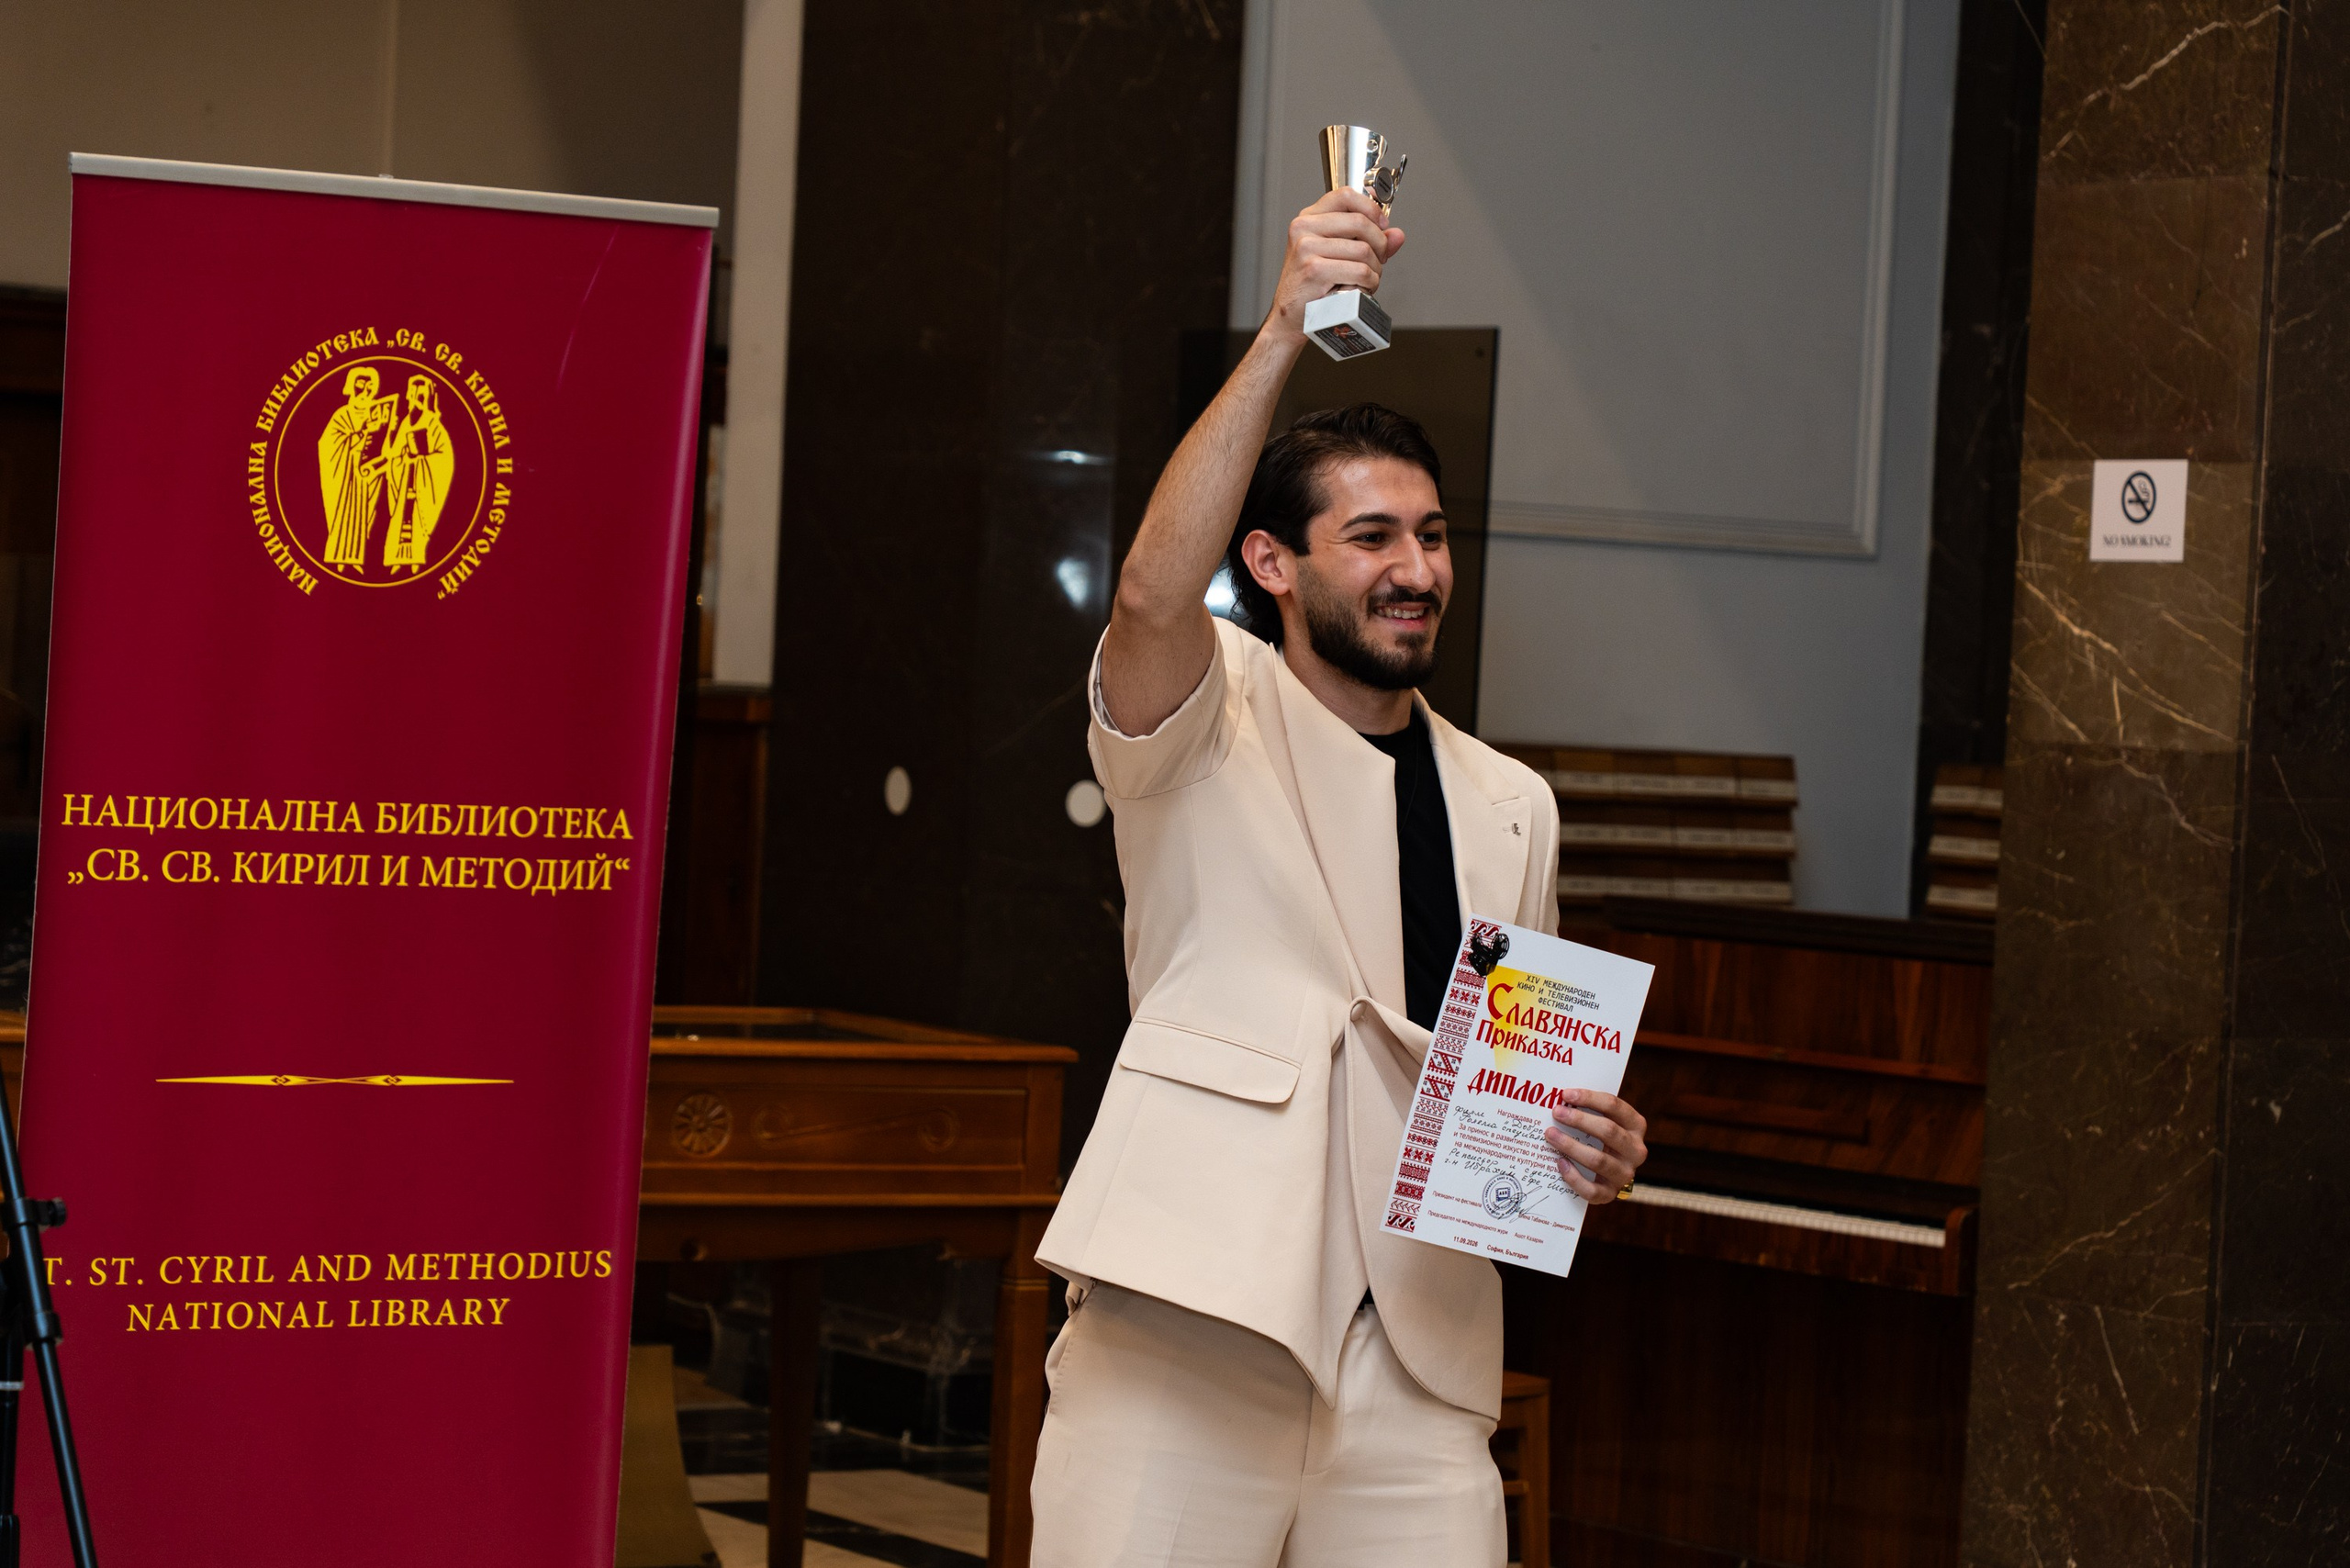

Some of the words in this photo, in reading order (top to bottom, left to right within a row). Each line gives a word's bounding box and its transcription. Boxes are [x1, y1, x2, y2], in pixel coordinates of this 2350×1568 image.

[435, 342, 464, 375] СВ.
[256, 327, 379, 433] БИБЛИОТЕКА
[464, 369, 511, 450] КИРИЛ
[497, 456, 513, 474] И
[248, 440, 319, 595] НАЦИОНАЛНА
[62, 793, 365, 835] НАЦИОНАЛНА
[375, 801, 634, 840] БИБЛИОТЕКА
[67, 848, 149, 885] „СВ.
[162, 850, 219, 883] СВ.
[231, 851, 371, 886] КИРИЛ
[380, 856, 410, 887] И
[419, 853, 631, 896] МЕТОДИЙ“
[1516, 981, 1536, 992] КИНО
[1548, 990, 1600, 1011] ТЕЛЕВИЗИОНЕН
[1526, 974, 1540, 984] XIV
[1542, 980, 1596, 1000] МЕЖДУНАРОДЕН
[1538, 997, 1574, 1013] ФЕСТИВАЛ
[1496, 1109, 1533, 1124] Награждава
[1460, 1133, 1501, 1148] телевизионно
[1503, 1144, 1530, 1156] изкуство
[1468, 1126, 1489, 1137] принос
[1495, 1134, 1530, 1148] развитието
[1464, 1144, 1516, 1162] международните
[1517, 1158, 1546, 1170] културни
[89, 1257, 143, 1286] ST.
[159, 1255, 274, 1284] CYRIL
[287, 1254, 372, 1282] AND
[384, 1250, 612, 1282] METHODIUS
[1505, 1249, 1529, 1260] България
[126, 1301, 334, 1332] NATIONAL
[347, 1297, 510, 1327] LIBRARY
